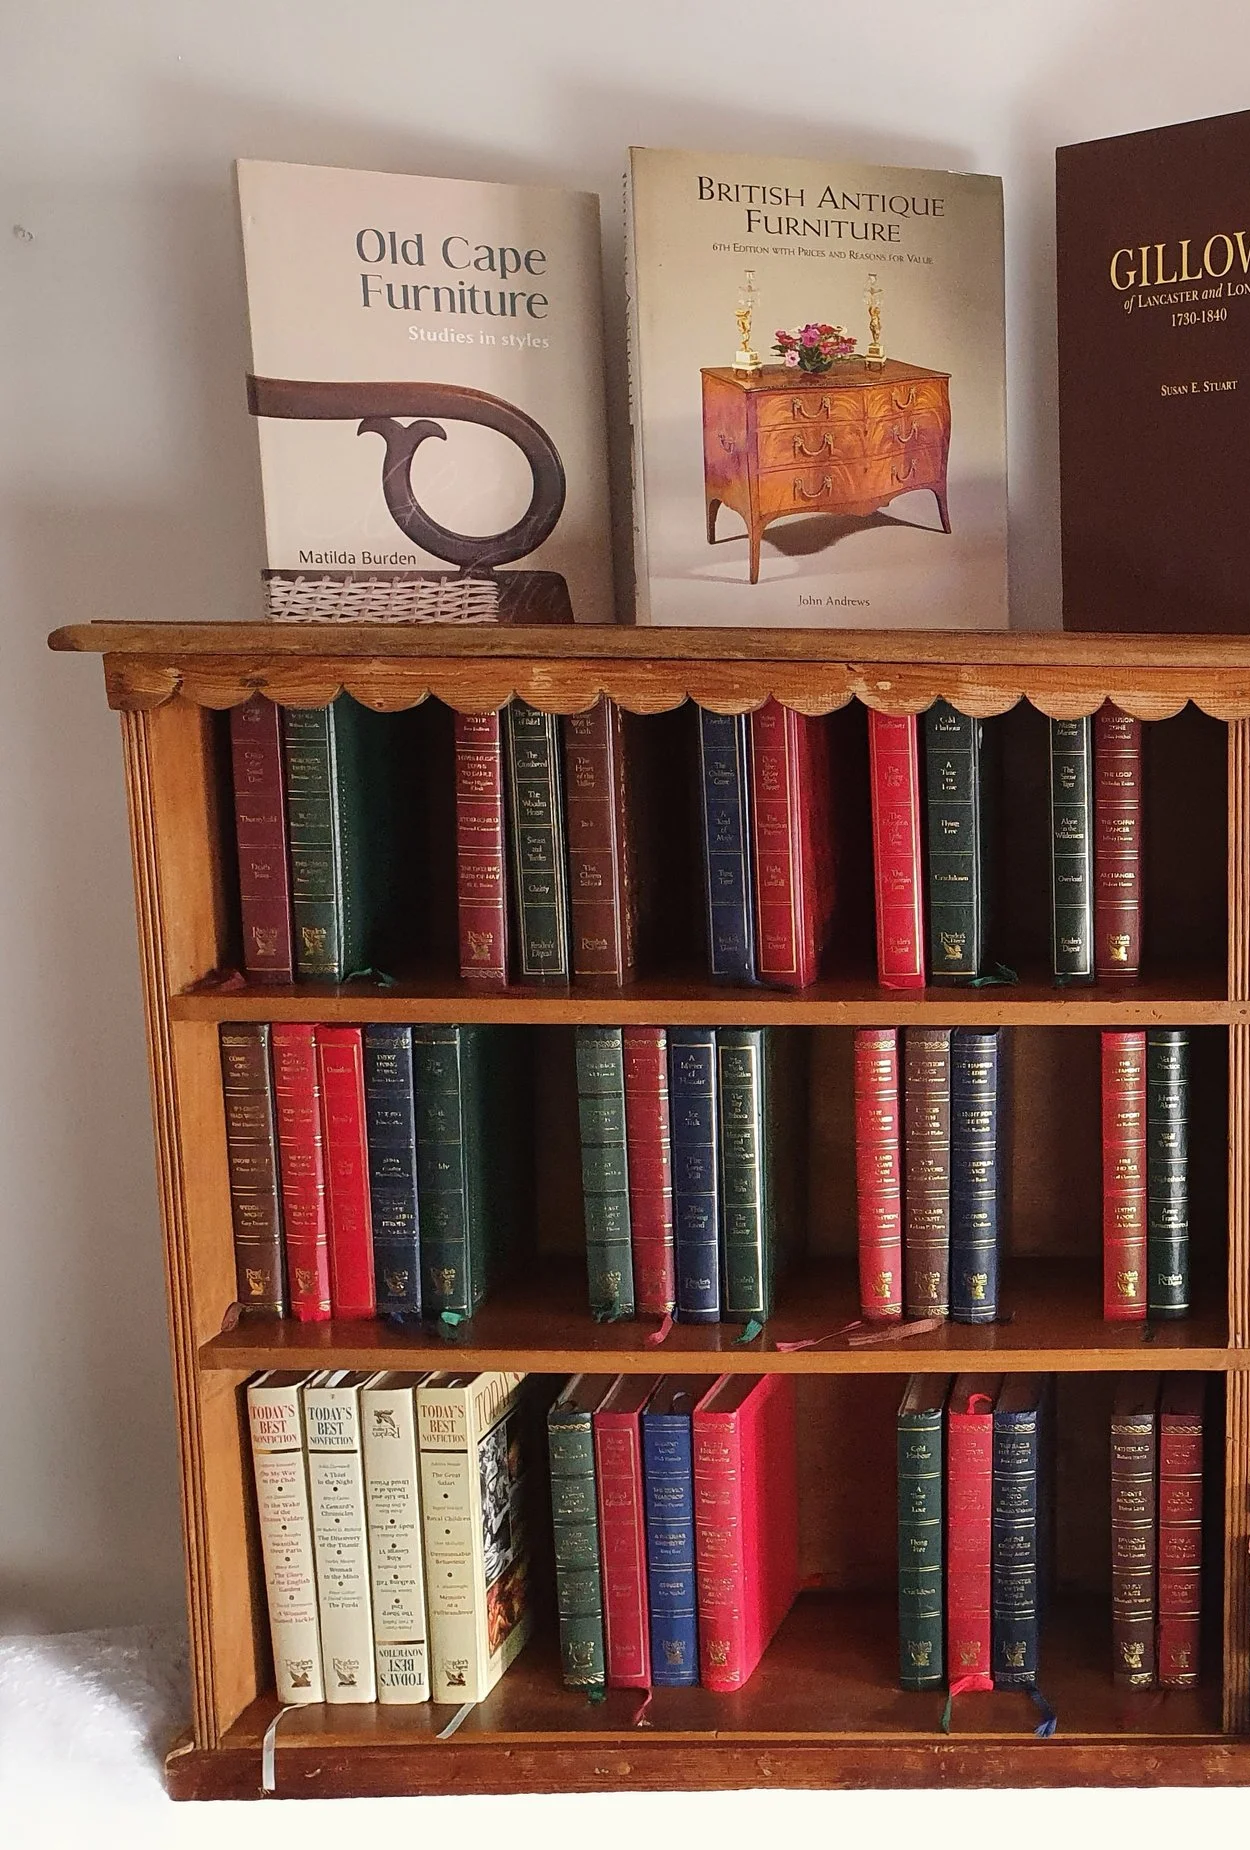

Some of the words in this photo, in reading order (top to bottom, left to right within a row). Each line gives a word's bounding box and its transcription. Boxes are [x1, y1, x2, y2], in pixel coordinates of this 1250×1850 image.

[697, 175, 806, 208] BRITISH
[817, 185, 945, 218] ANTIQUE
[745, 209, 901, 243] FURNITURE
[356, 228, 425, 267] Old
[442, 236, 547, 280] Cape
[712, 243, 731, 252] 6TH
[773, 247, 795, 256] WITH
[829, 250, 846, 259] AND
[888, 253, 904, 263] FOR
[360, 273, 550, 320] Furniture
[1123, 294, 1137, 314] of
[1138, 290, 1199, 308] LANCASTER
[1202, 283, 1223, 300] and
[1171, 307, 1228, 327] 1730-1840
[408, 326, 474, 345] Studies
[480, 331, 496, 345] in
[501, 332, 550, 350] styles
[1160, 384, 1189, 397] SUSAN
[1191, 382, 1200, 394] E.
[1203, 380, 1238, 393] STUART
[299, 549, 356, 565] Matilda
[361, 551, 417, 565] Burden
[798, 594, 823, 607] John
[826, 595, 871, 607] Andrews
[250, 1404, 296, 1420] TODAY'S
[307, 1406, 353, 1421] TODAY'S
[420, 1404, 465, 1420] TODAY'S
[259, 1420, 287, 1434] BEST
[317, 1421, 345, 1436] BEST
[429, 1419, 457, 1433] BEST
[253, 1434, 298, 1445] NONFICTION
[309, 1436, 354, 1446] NONFICTION
[422, 1433, 466, 1443] NONFICTION
[379, 1648, 424, 1658] NONFICTION
[387, 1658, 415, 1672] BEST
[379, 1672, 425, 1687] TODAY'S
